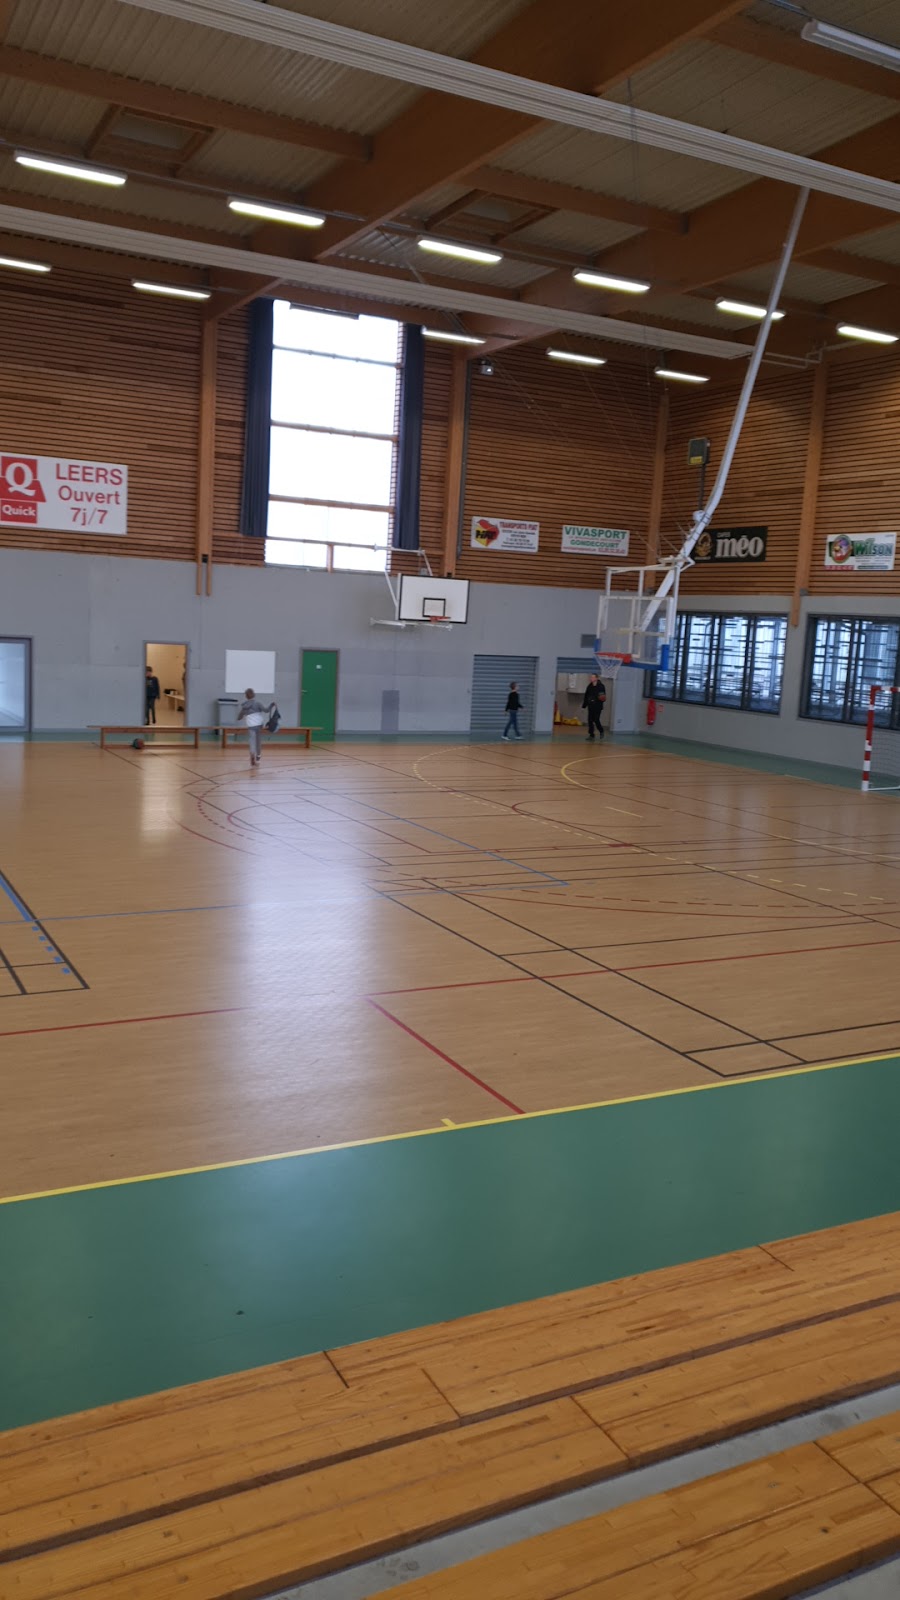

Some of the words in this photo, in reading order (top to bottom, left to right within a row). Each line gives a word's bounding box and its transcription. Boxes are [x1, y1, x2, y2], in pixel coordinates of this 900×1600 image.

[55, 463, 123, 485] LEERS
[58, 485, 120, 505] Ouvert
[2, 504, 36, 516] Quick
[70, 507, 108, 526] 7j/7
[564, 526, 627, 540] VIVASPORT
[570, 539, 620, 549] GONDECOURT
